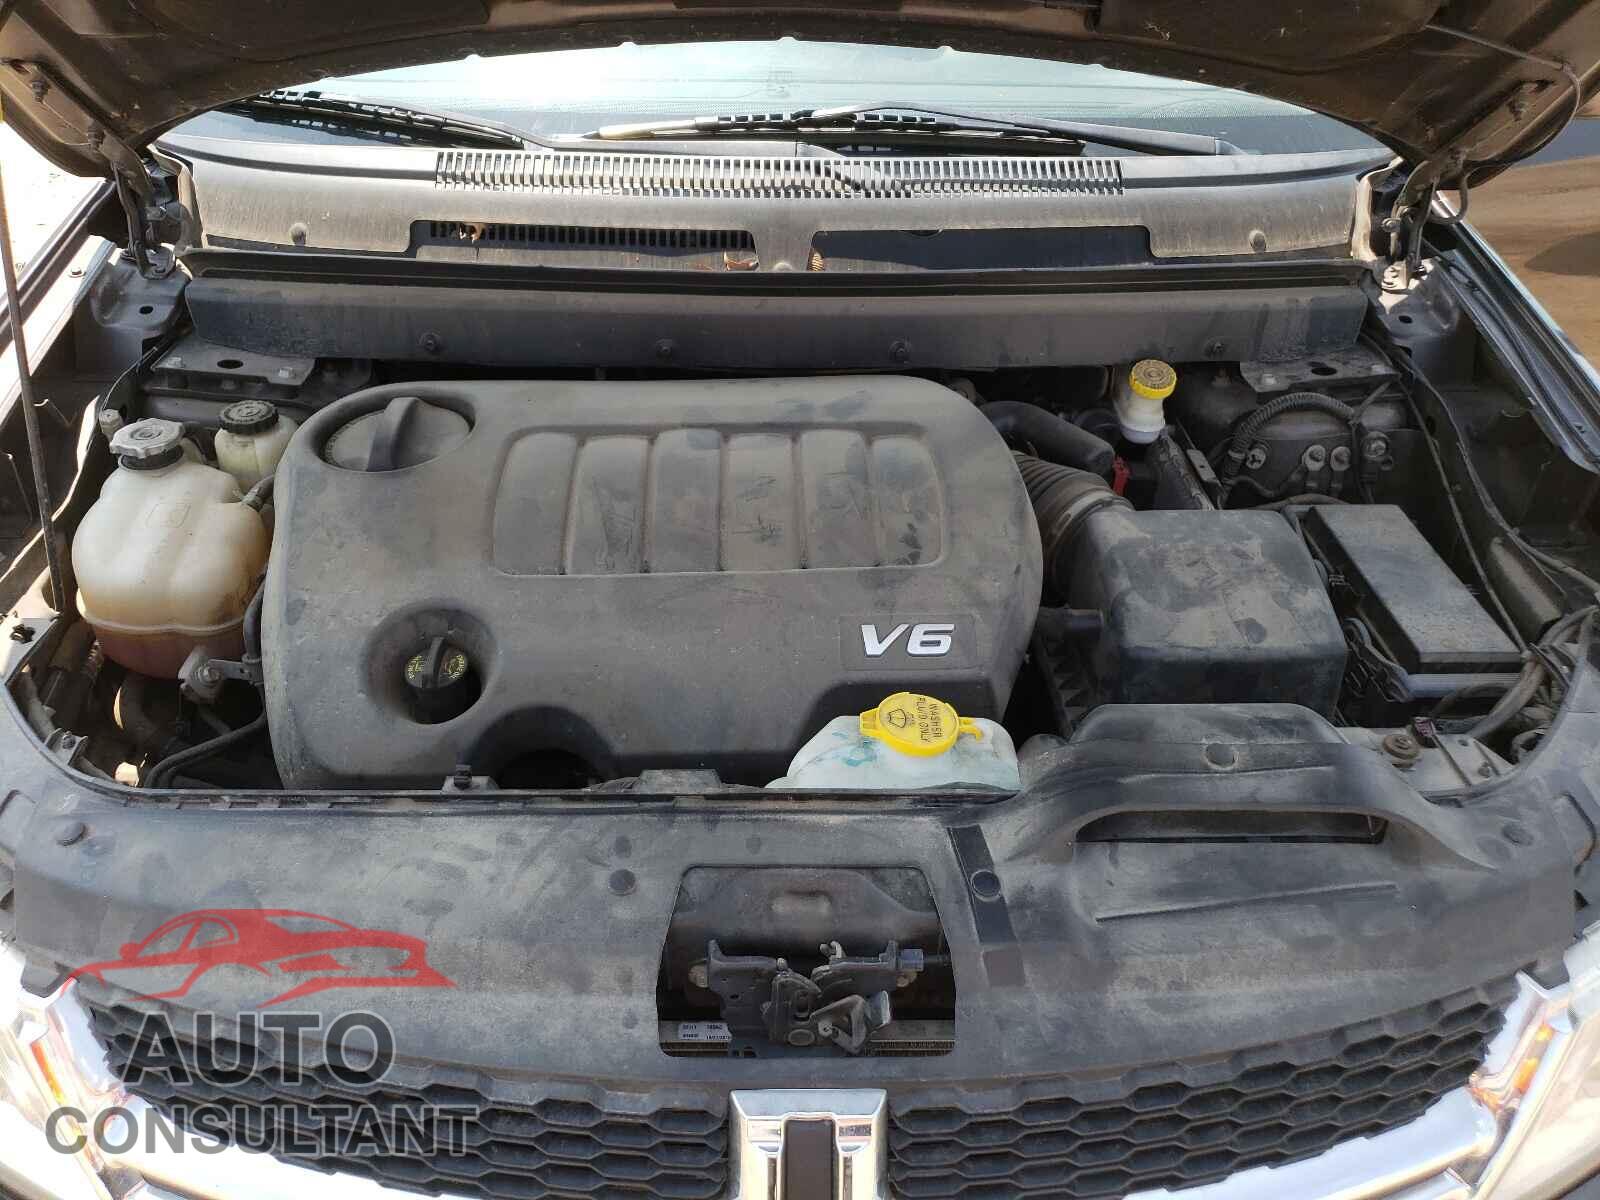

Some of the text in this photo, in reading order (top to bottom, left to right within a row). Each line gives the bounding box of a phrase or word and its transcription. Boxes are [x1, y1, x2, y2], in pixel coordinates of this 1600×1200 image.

[861, 623, 955, 657] V6
[916, 697, 931, 743] FLUID ONLY
[928, 703, 943, 738] WASHER
